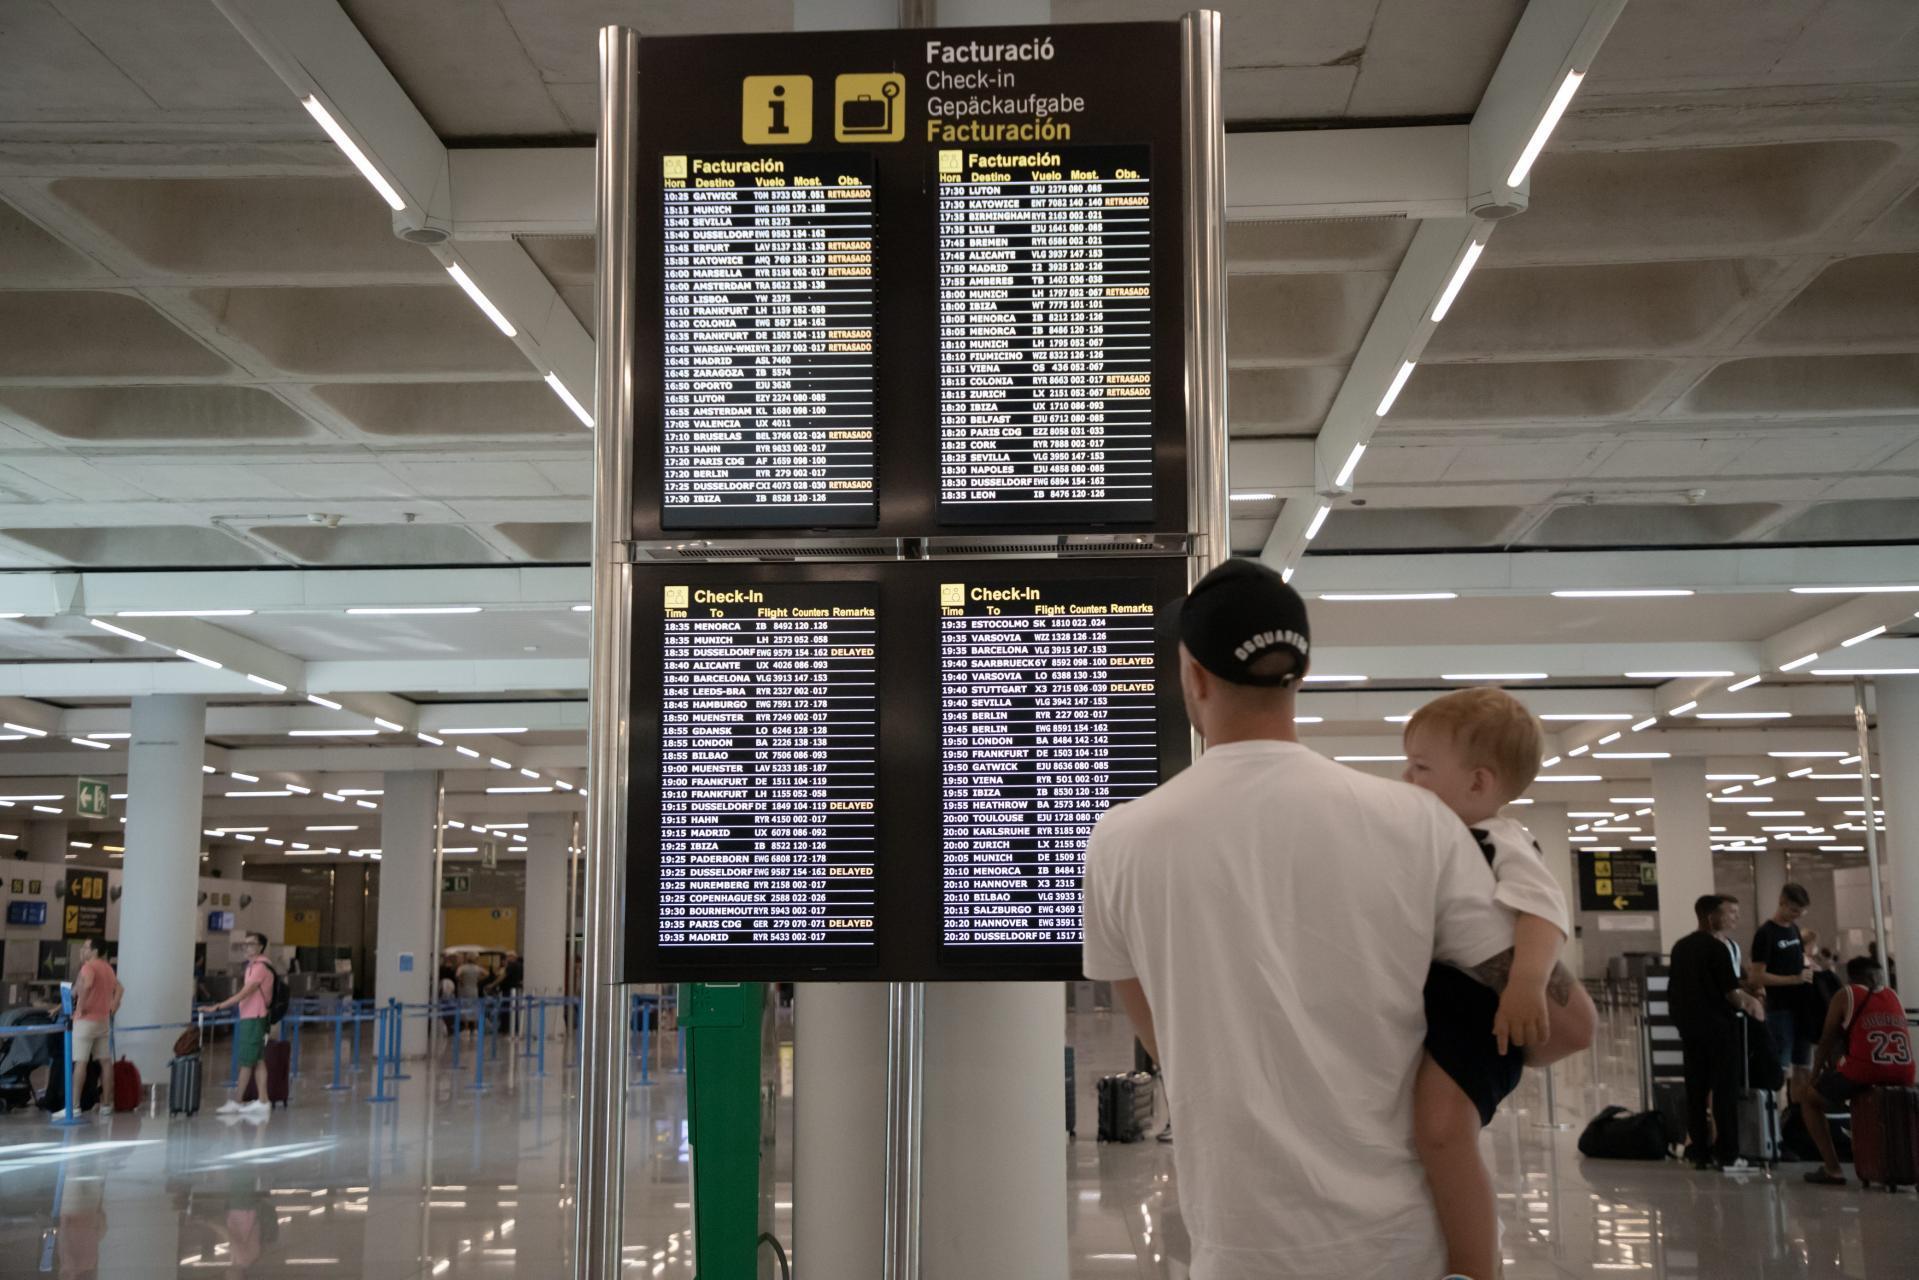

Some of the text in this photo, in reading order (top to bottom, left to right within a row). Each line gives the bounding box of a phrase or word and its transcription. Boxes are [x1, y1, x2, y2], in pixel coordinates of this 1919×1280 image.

[926, 37, 1054, 63] Facturació
[926, 70, 1015, 90] Check-in
[928, 94, 1085, 118] Gepäckaufgabe
[928, 118, 1071, 142] Facturación
[969, 153, 1060, 168] Facturación
[693, 159, 784, 173] Facturación
[940, 169, 1140, 182] Hora Destino Vuelo Most. Obs.
[665, 176, 862, 188] Hora Destino Vuelo Most. Obs.
[694, 192, 738, 200] GATWICK
[970, 198, 1148, 208] KATOWICE RETRASADO
[694, 206, 731, 214] MUNICH
[694, 242, 871, 252] ERFURT RETRASADO
[828, 255, 871, 263] RETRASADO
[969, 251, 1016, 259] ALICANTE
[828, 268, 871, 276] RETRASADO
[970, 264, 1008, 272] MADRID
[693, 282, 751, 290] AMSTERDAM
[970, 288, 1149, 298] MUNICH RETRASADO
[693, 332, 748, 340] FRANKFURT
[829, 343, 871, 351] RETRASADO
[970, 340, 1008, 348] MUNICH
[970, 352, 1022, 360] FIUMICINO
[970, 364, 1000, 372] VIENA
[970, 377, 1013, 385] COLONIA
[694, 382, 732, 390] OPORTO
[970, 388, 1150, 398] ZURICH RETRASADO
[694, 420, 740, 428] VALENCIA
[829, 431, 871, 439] RETRASADO
[694, 445, 720, 453] HAHN
[970, 441, 996, 449] CORK
[694, 470, 728, 478] BERLIN
[971, 466, 1014, 474] NAPOLES
[971, 491, 995, 499] LEON
[695, 590, 763, 603] Check-In
[971, 587, 1040, 601] Check-In
[665, 607, 875, 619] Time To Flight Counters Remarks
[942, 604, 1153, 616] Time To Flight Counters Remarks
[665, 623, 689, 631] 18:35
[972, 620, 1029, 628] ESTOCOLMO
[694, 636, 732, 644] MUNICH
[972, 634, 1021, 642] VARSOVIA
[664, 649, 689, 657] 18:35
[831, 648, 873, 656] DELAYED
[664, 661, 740, 670] 18:40 ALICANTE
[971, 658, 1153, 667] SAARBRUECK DELAYED
[664, 675, 688, 683] 18:40
[972, 672, 1022, 680] VARSOVIA
[664, 688, 745, 696] 18:45 LEEDS-BRA
[1110, 684, 1153, 692] DELAYED
[663, 701, 688, 709] 18:45
[972, 699, 1012, 707] SEVILLA
[663, 714, 744, 722] 18:50 MUENSTER
[972, 712, 1007, 720] BERLIN
[663, 727, 732, 735] 18:55 GDANSK
[972, 725, 1007, 733] BERLIN
[692, 739, 732, 747] LONDON
[972, 737, 1013, 745] LONDON
[692, 752, 728, 760] BILBAO
[972, 750, 1028, 758] FRANKFURT
[662, 765, 687, 773] 19:00
[973, 763, 1018, 771] GATWICK
[662, 778, 687, 786] 19:00
[973, 776, 1003, 784] VIENA
[692, 790, 747, 798] FRANKFURT
[662, 802, 873, 811] 19:15 DUSSELDORF DELAYED
[662, 816, 718, 824] 19:15 HAHN
[973, 814, 1023, 822] TOULOUSE
[661, 829, 730, 837] 19:15 MADRID
[973, 827, 1030, 835] KARLSRUHE
[661, 842, 718, 851] 19:25 IBIZA
[690, 855, 749, 863] PADERBORN
[973, 854, 1012, 862] MUNICH
[973, 867, 1021, 875] MENORCA
[690, 881, 749, 889] NUREMBERG
[974, 880, 1027, 888] HANNOVER
[660, 894, 752, 903] 19:25 COPENHAGUE
[690, 907, 752, 915] BOURNEMOUT
[974, 906, 1031, 914] SALZBURGO
[690, 920, 719, 928] PARIS
[722, 920, 741, 928] CDG
[974, 919, 1028, 927] HANNOVER
[659, 934, 684, 942] 19:35
[974, 932, 1038, 940] DUSSELDORF
[1868, 1031, 1912, 1064] 23
